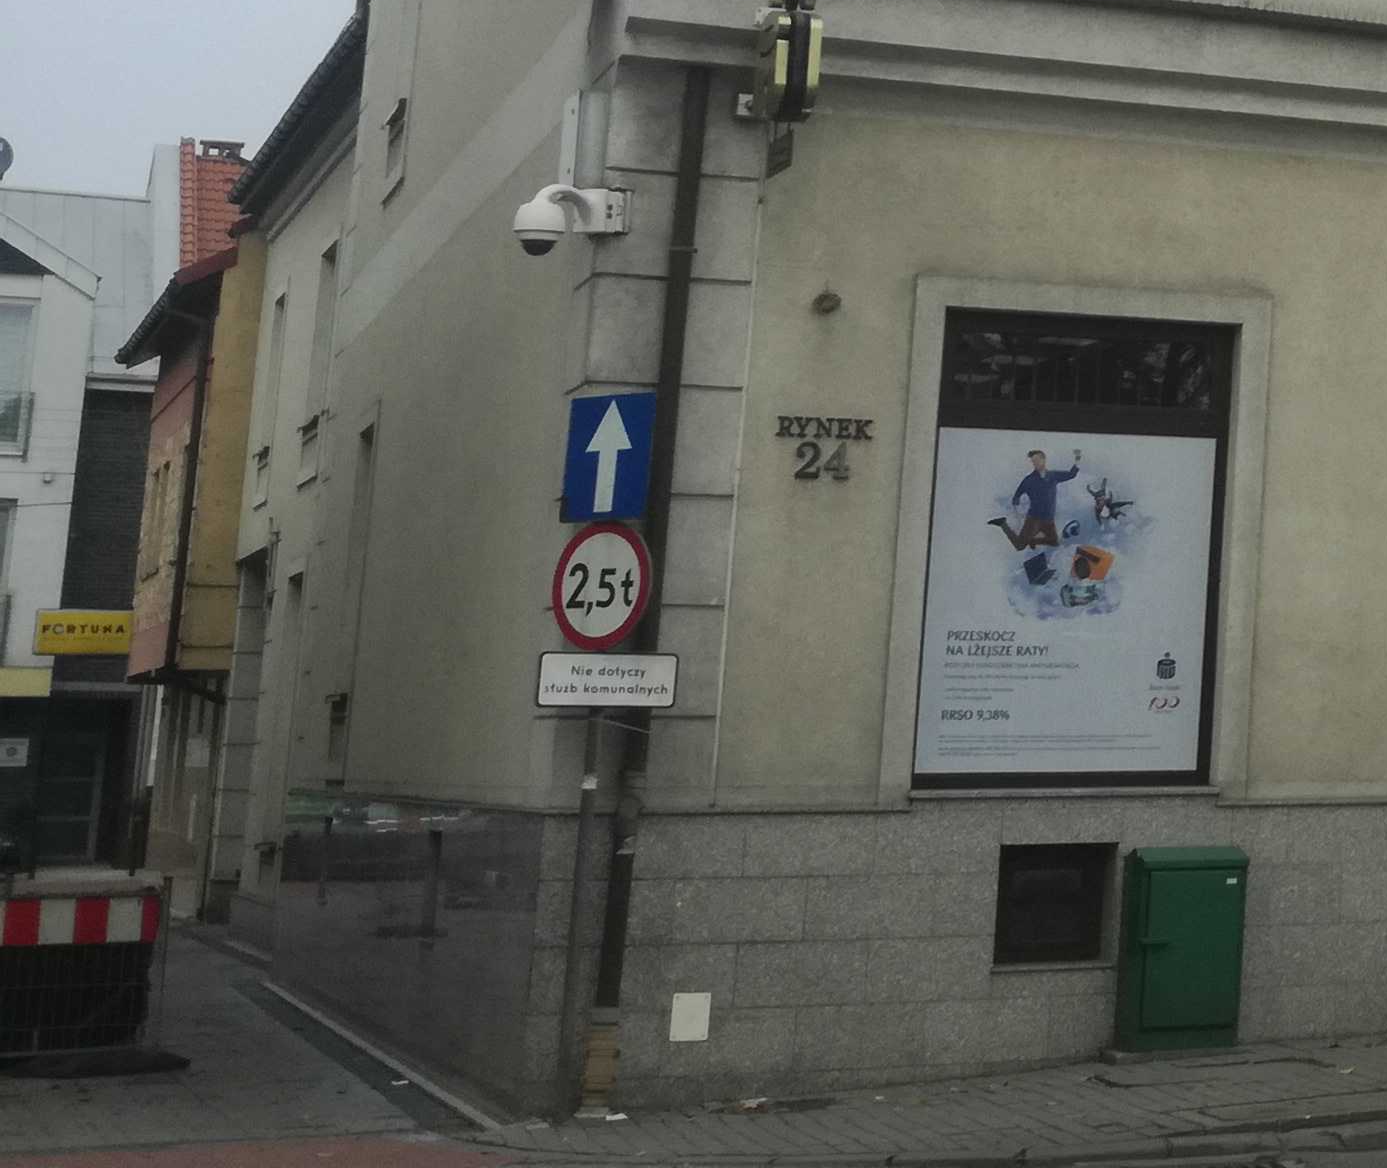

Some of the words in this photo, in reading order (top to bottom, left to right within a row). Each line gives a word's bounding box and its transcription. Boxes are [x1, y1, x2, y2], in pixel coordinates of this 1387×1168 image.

[776, 416, 874, 440] RYNEK
[794, 441, 850, 480] 24
[41, 623, 125, 635] FORTUNA
[947, 630, 1016, 642] PRZESKOCZ
[946, 646, 964, 656] NA
[1017, 646, 1049, 657] RATY!
[571, 666, 593, 676] Nie
[598, 665, 647, 679] dotyczy
[583, 684, 668, 696] komunalnych
[941, 710, 974, 720] RRSO
